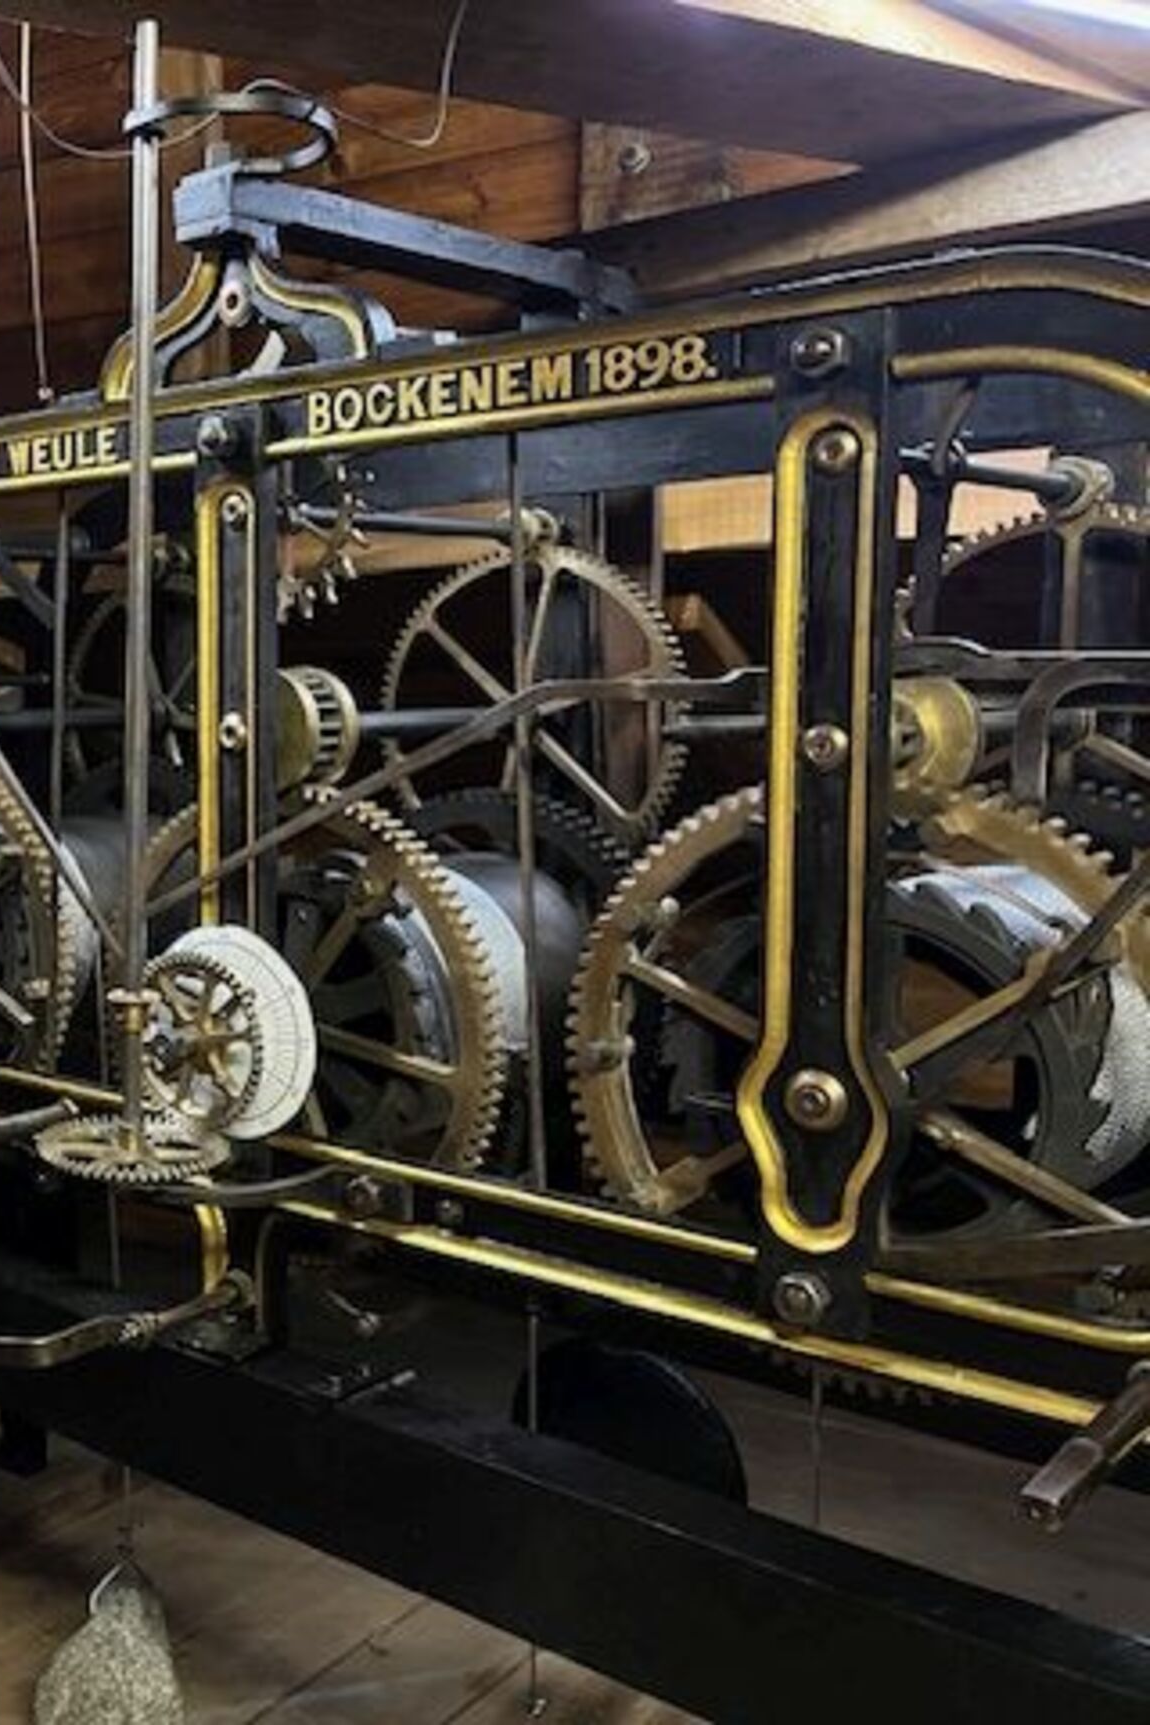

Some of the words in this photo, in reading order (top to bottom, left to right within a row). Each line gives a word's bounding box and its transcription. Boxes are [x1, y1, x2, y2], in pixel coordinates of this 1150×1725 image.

[307, 353, 573, 437] BOCKENEM
[585, 336, 717, 394] 1898.
[8, 427, 118, 475] WEULE
